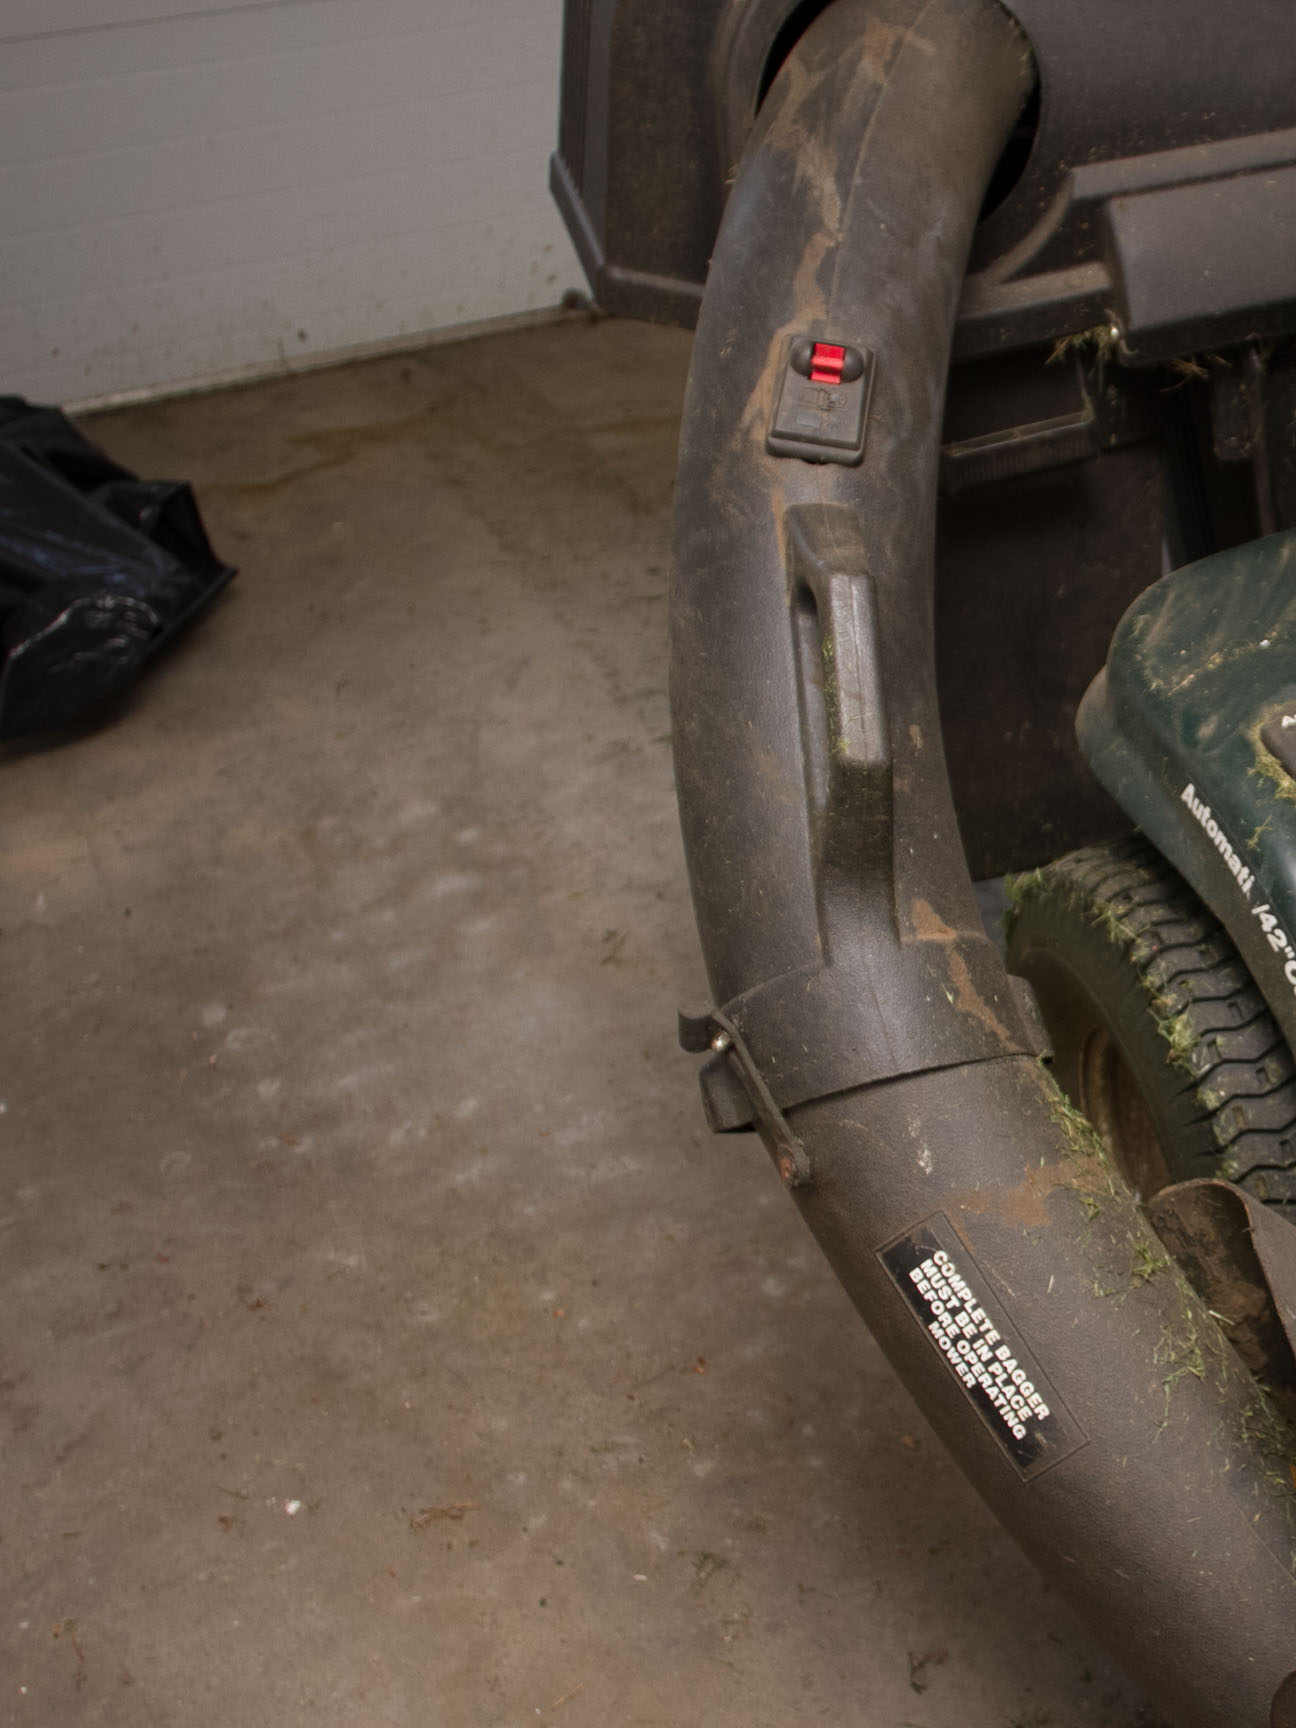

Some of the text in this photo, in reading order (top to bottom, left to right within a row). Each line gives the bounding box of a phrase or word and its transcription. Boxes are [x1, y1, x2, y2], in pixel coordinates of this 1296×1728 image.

[1181, 783, 1255, 900] Automati
[909, 1267, 1027, 1440] BEFORE OPERATING
[920, 1258, 1033, 1422] MUST BE IN PLACE
[928, 1321, 976, 1388] MOWER
[933, 1250, 1050, 1420] COMPLETE BAGGER
